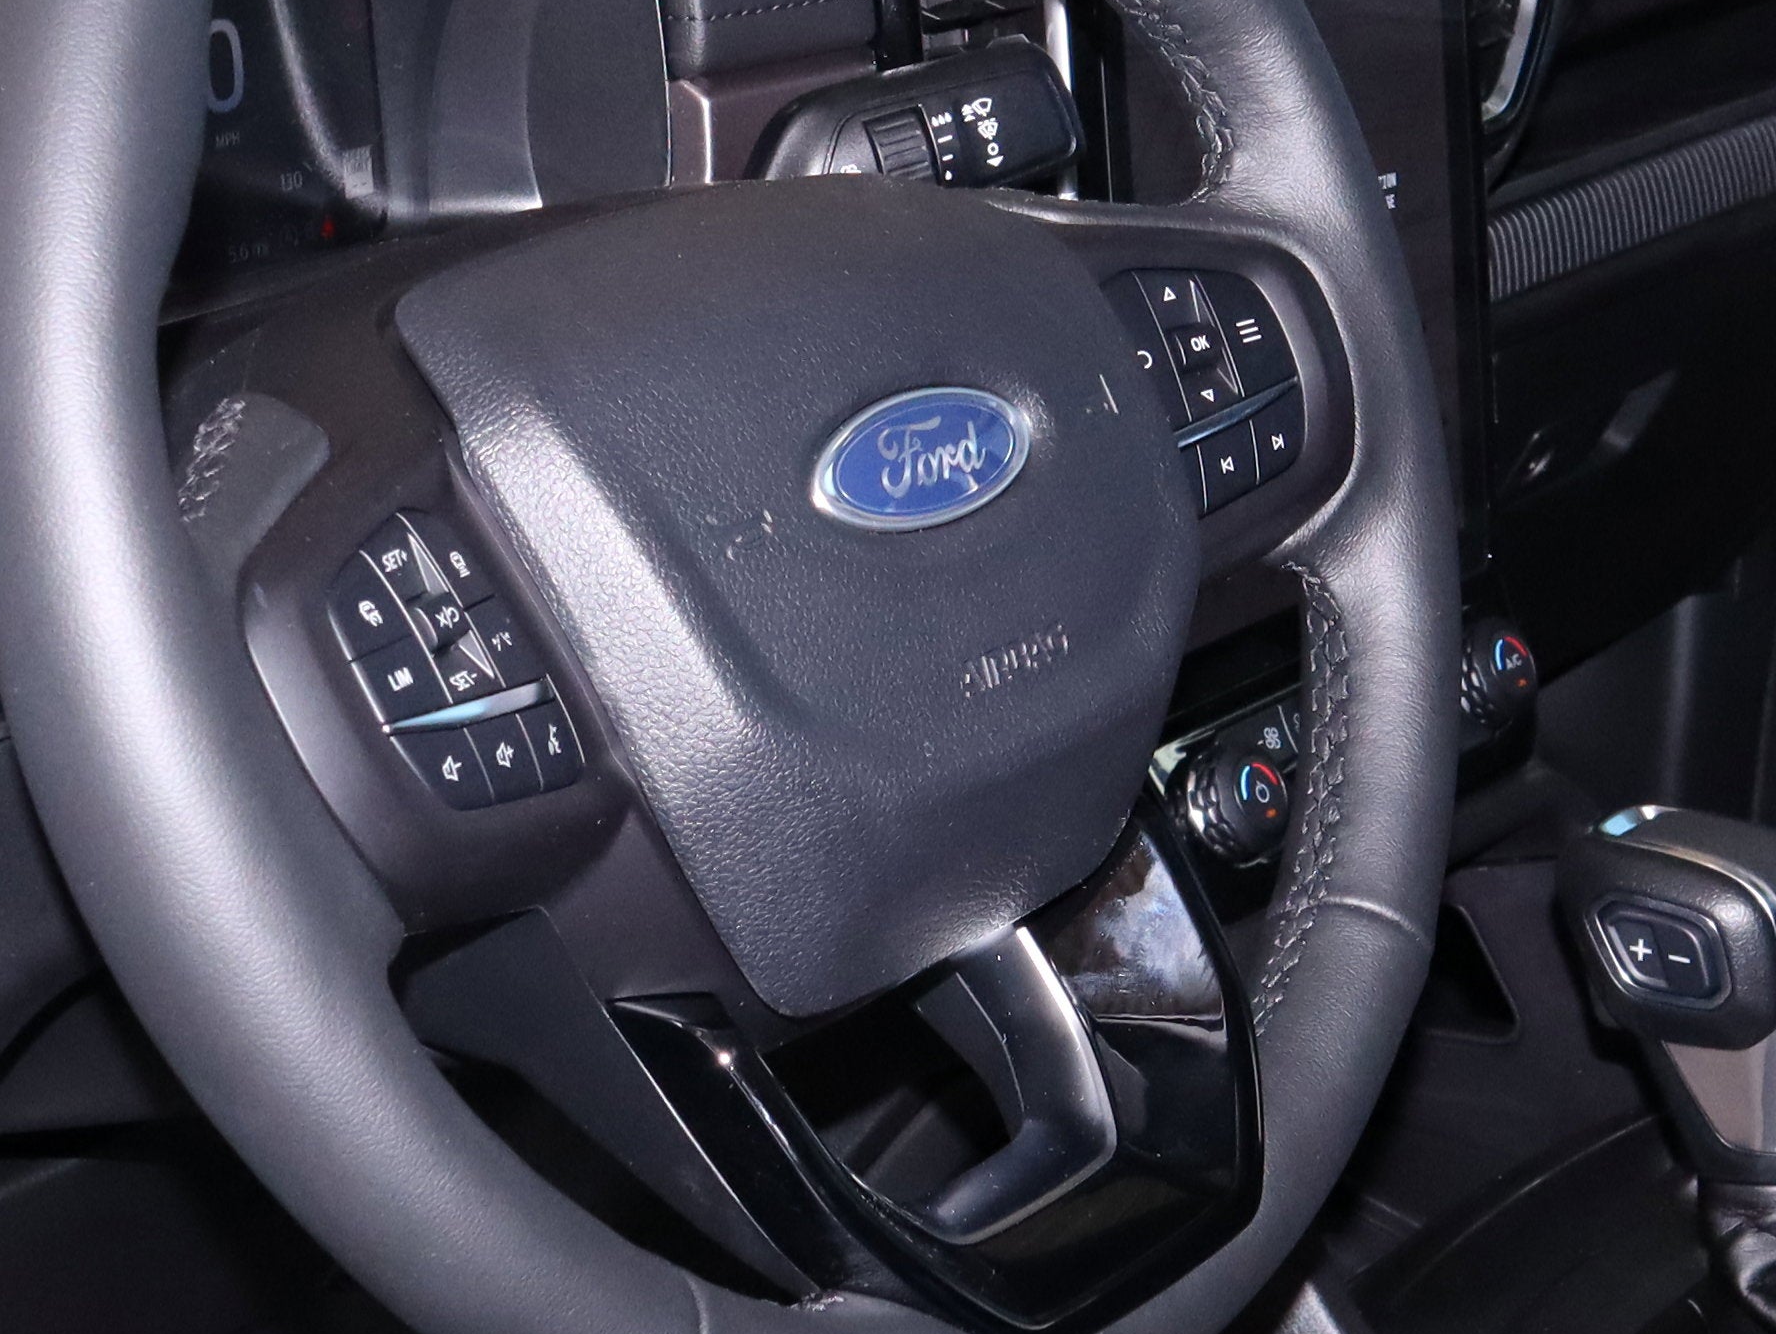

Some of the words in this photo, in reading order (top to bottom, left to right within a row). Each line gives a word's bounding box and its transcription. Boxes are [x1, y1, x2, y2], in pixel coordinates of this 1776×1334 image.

[1190, 334, 1211, 352] OK
[877, 416, 987, 499] Ford
[381, 548, 409, 573] SET+
[387, 667, 414, 692] LIM
